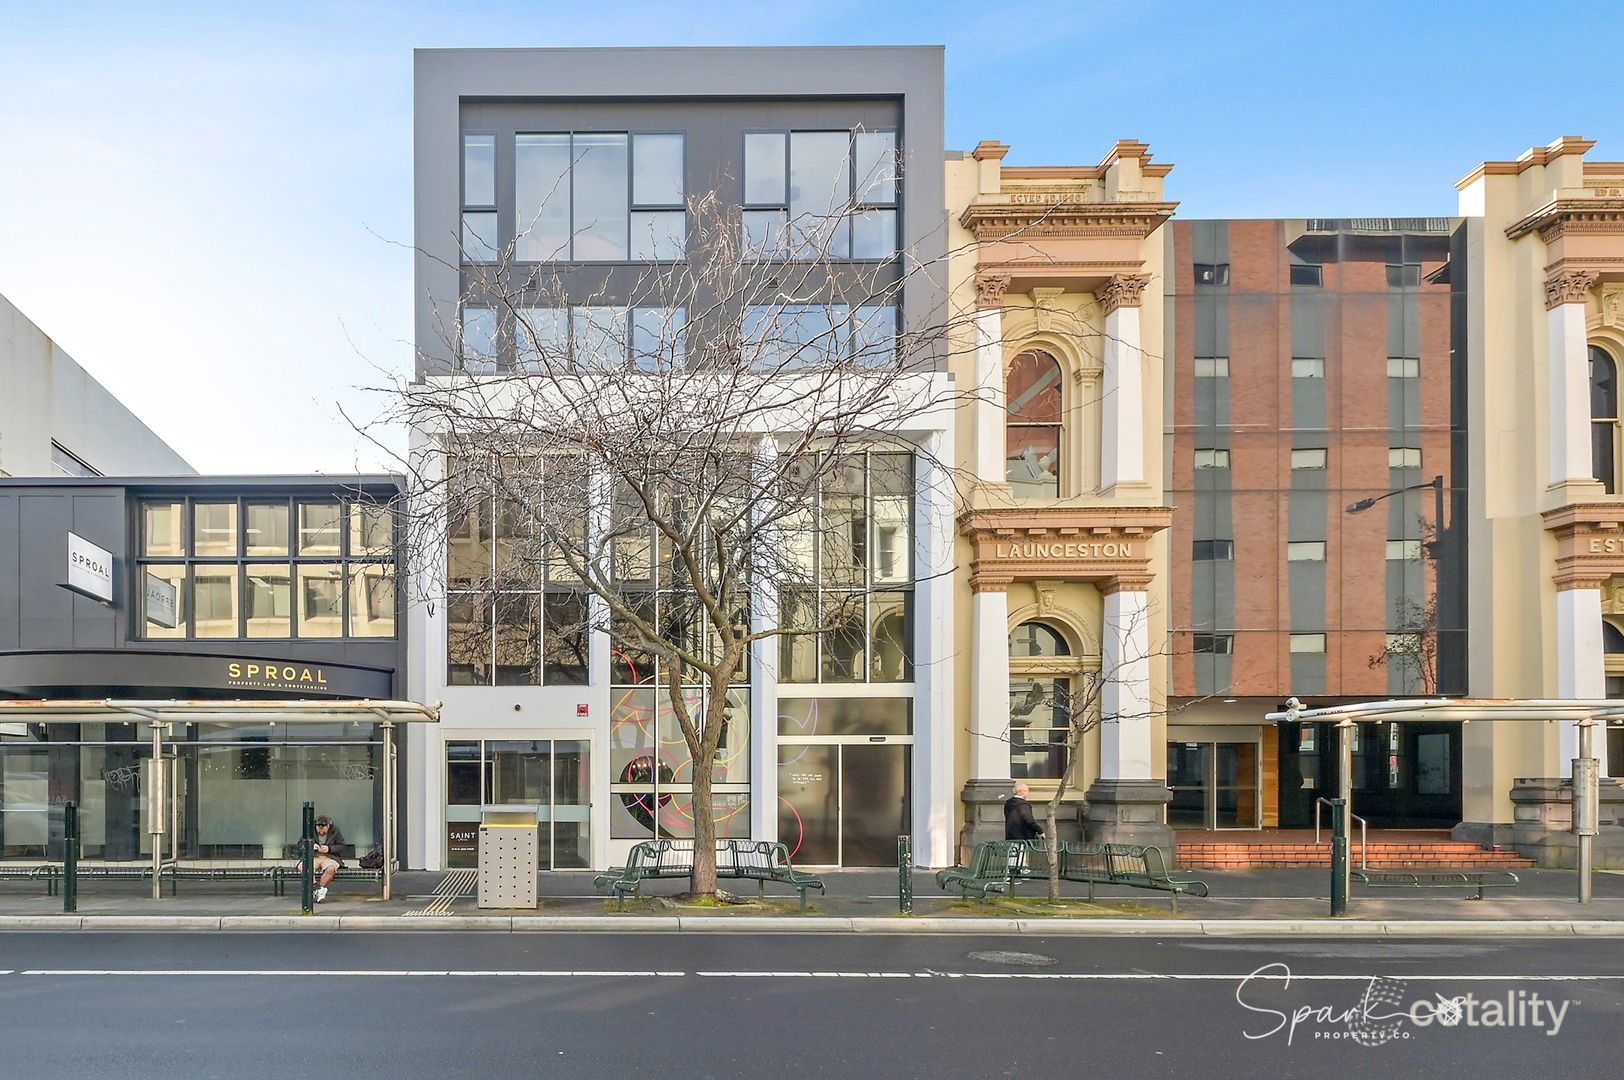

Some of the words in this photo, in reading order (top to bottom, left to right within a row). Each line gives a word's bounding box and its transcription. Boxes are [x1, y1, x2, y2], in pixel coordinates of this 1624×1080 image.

[996, 543, 1132, 558] LAUNCESTON
[72, 552, 110, 578] SPROAL
[228, 663, 328, 684] SPROAL
